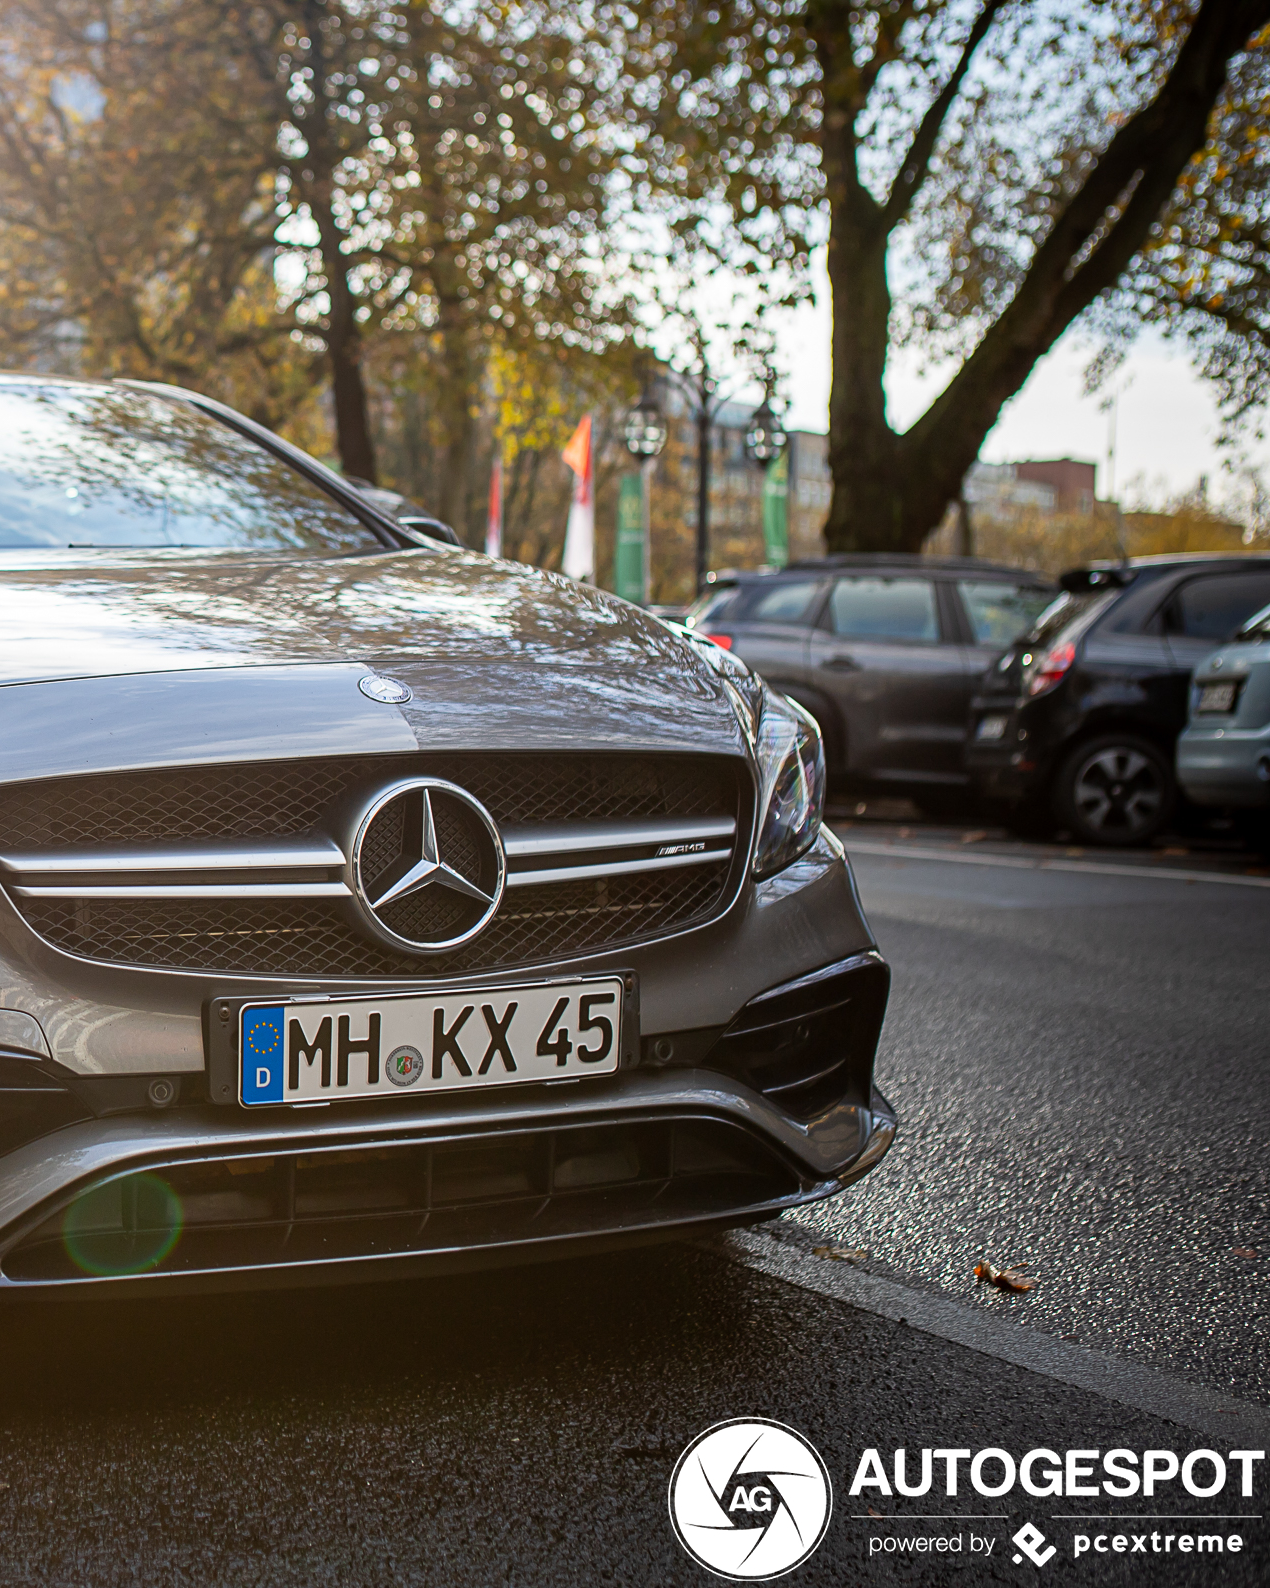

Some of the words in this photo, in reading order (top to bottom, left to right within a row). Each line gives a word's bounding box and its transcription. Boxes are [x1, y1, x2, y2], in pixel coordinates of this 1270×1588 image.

[287, 1012, 382, 1090] MH
[431, 1001, 519, 1080] KX
[536, 992, 615, 1067] 45
[255, 1066, 272, 1089] D
